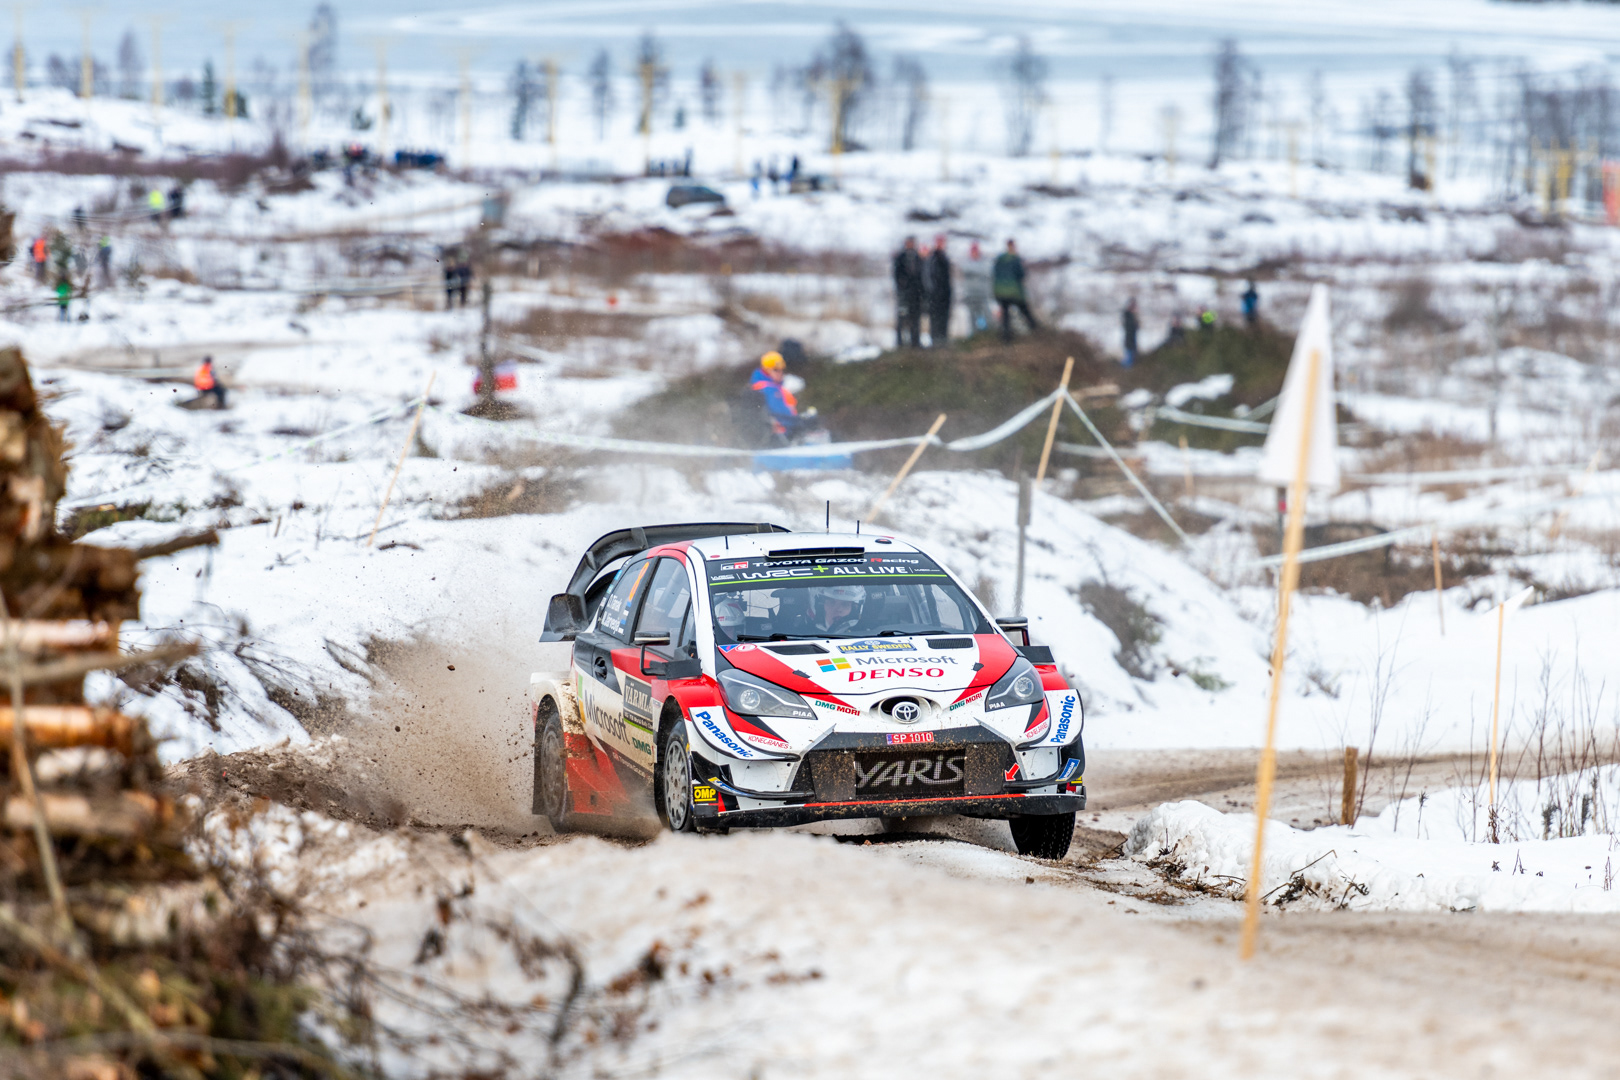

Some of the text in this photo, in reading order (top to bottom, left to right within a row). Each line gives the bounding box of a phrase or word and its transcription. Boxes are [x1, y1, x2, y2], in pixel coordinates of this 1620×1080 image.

[752, 559, 812, 567] TOYOTA
[833, 566, 866, 575] ALL
[868, 566, 908, 574] LIVE
[839, 644, 869, 652] RALLY
[872, 642, 912, 650] SWEDEN
[855, 655, 958, 666] Microsoft
[848, 667, 945, 682] DENSO
[815, 700, 861, 716] DMG MORI
[949, 692, 983, 711] DMG MORI
[989, 701, 1006, 710] PIAA
[585, 689, 631, 745] Microsoft
[792, 710, 812, 718] PIAA
[1050, 695, 1076, 744] Panasonic
[695, 710, 754, 758] Panasonic
[893, 732, 933, 743] SP 1010
[632, 737, 652, 755] DMG
[748, 735, 790, 750] KONECRANES
[694, 788, 717, 799] OMP
